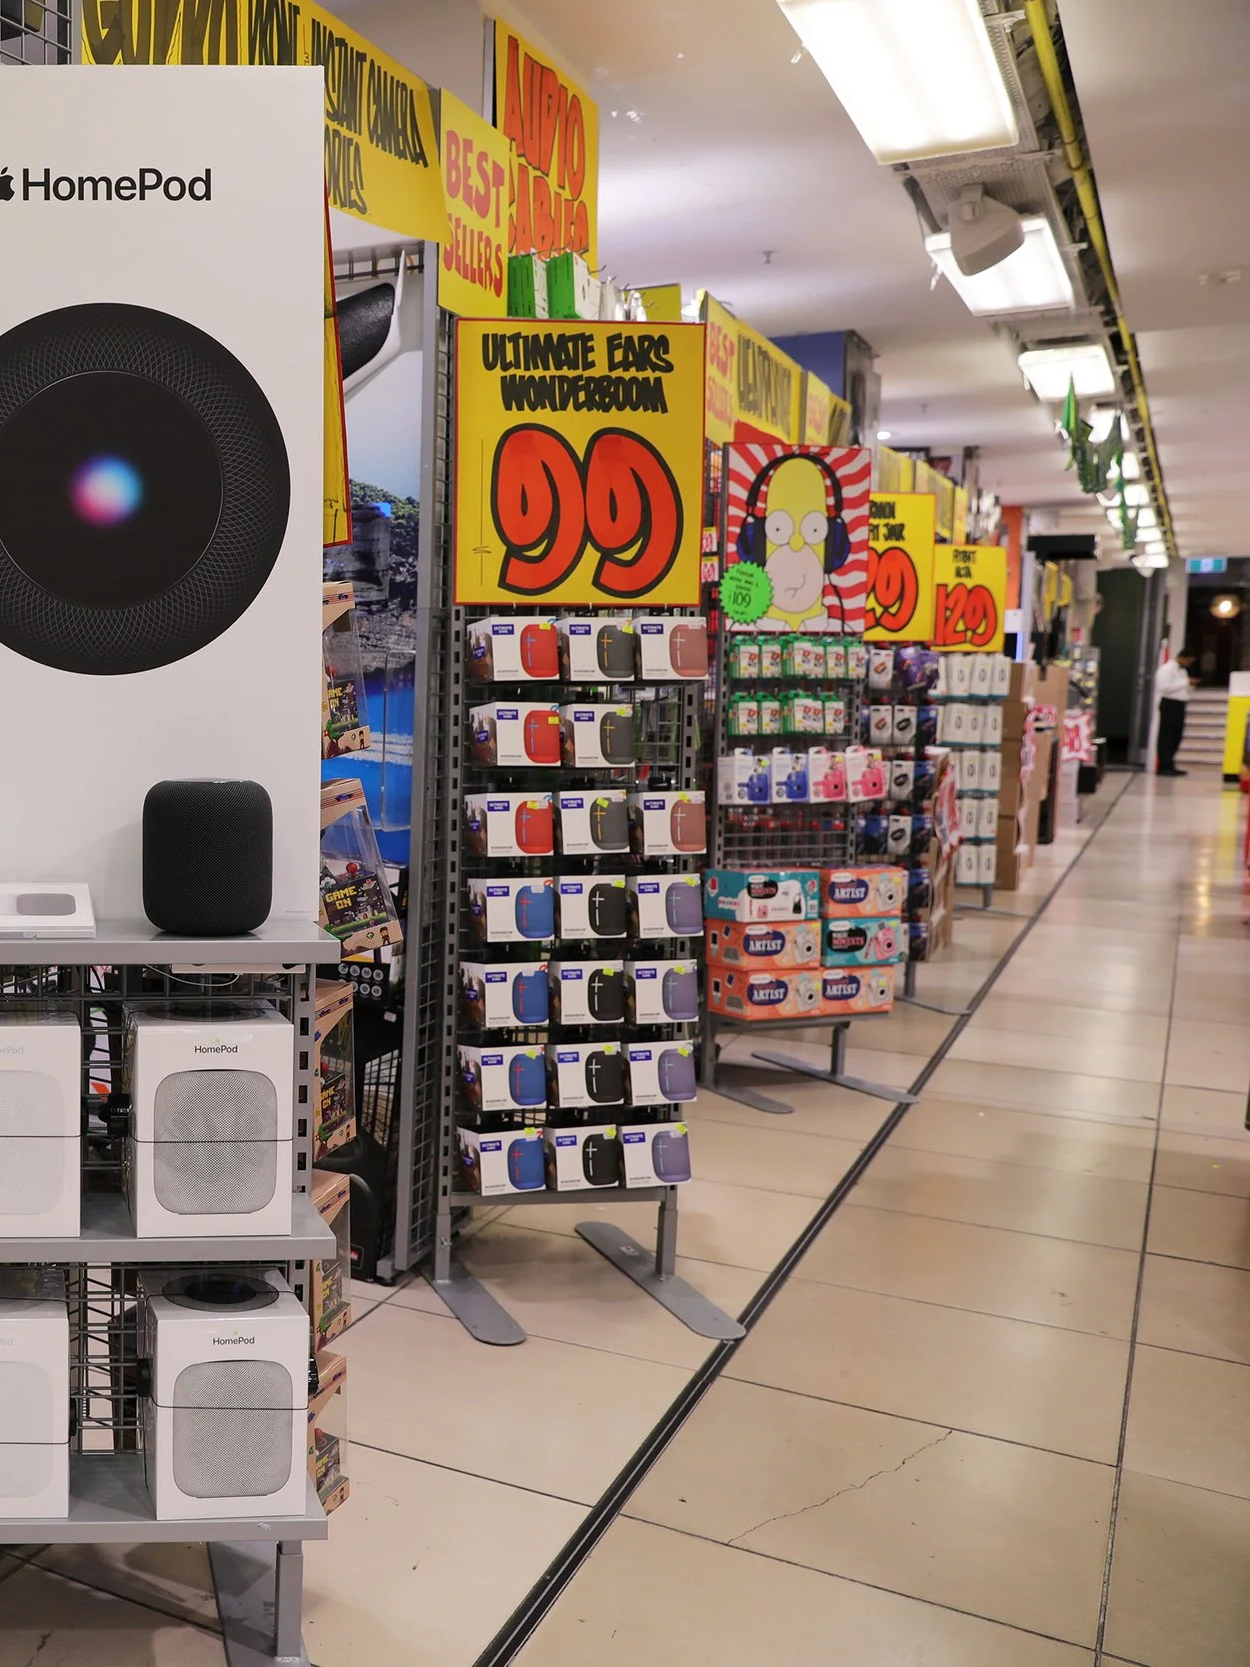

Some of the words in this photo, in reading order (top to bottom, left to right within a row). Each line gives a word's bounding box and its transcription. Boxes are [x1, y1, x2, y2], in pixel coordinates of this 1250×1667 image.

[367, 58, 429, 169] CAMERA
[503, 35, 586, 201] AUDIO
[21, 167, 212, 203] HomePod
[446, 129, 505, 229] BEST
[444, 213, 504, 298] SELLERS
[481, 331, 597, 372] ULTIMATE
[606, 332, 675, 374] EARS
[500, 374, 669, 414] WONDERBOOM
[935, 582, 998, 648] 129
[325, 885, 357, 904] GAME
[335, 897, 352, 911] ON
[833, 887, 867, 900] ARTIST
[748, 939, 783, 953] ARTIST
[752, 988, 787, 1002] ARTIST
[824, 983, 859, 997] ARTIST
[194, 1044, 238, 1054] HomePod
[212, 1336, 255, 1346] HomePod
